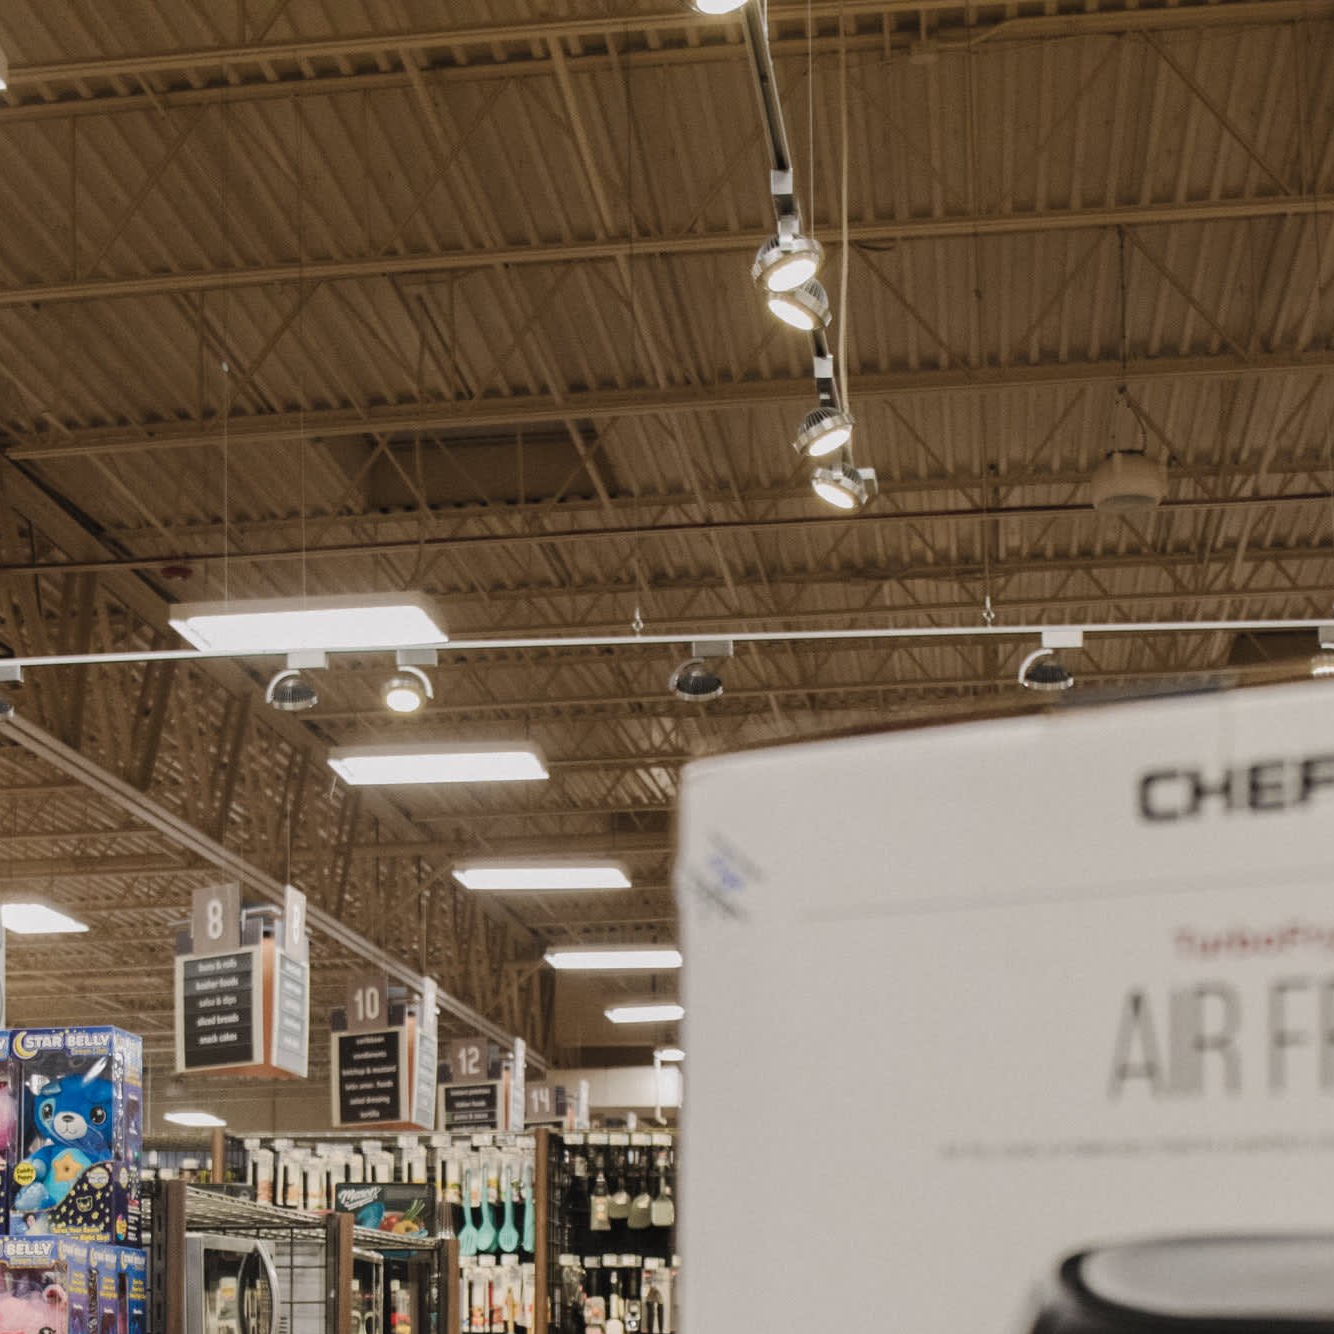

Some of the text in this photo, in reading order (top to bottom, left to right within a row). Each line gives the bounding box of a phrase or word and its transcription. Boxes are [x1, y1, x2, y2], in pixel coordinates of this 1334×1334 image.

[207, 898, 223, 939] 8
[355, 987, 380, 1021] 10
[26, 1033, 110, 1048] STAR BELLY
[1107, 982, 1243, 1100] AIR
[458, 1046, 480, 1075] 12
[531, 1088, 549, 1114] 14
[6, 1242, 52, 1257] BELLY
